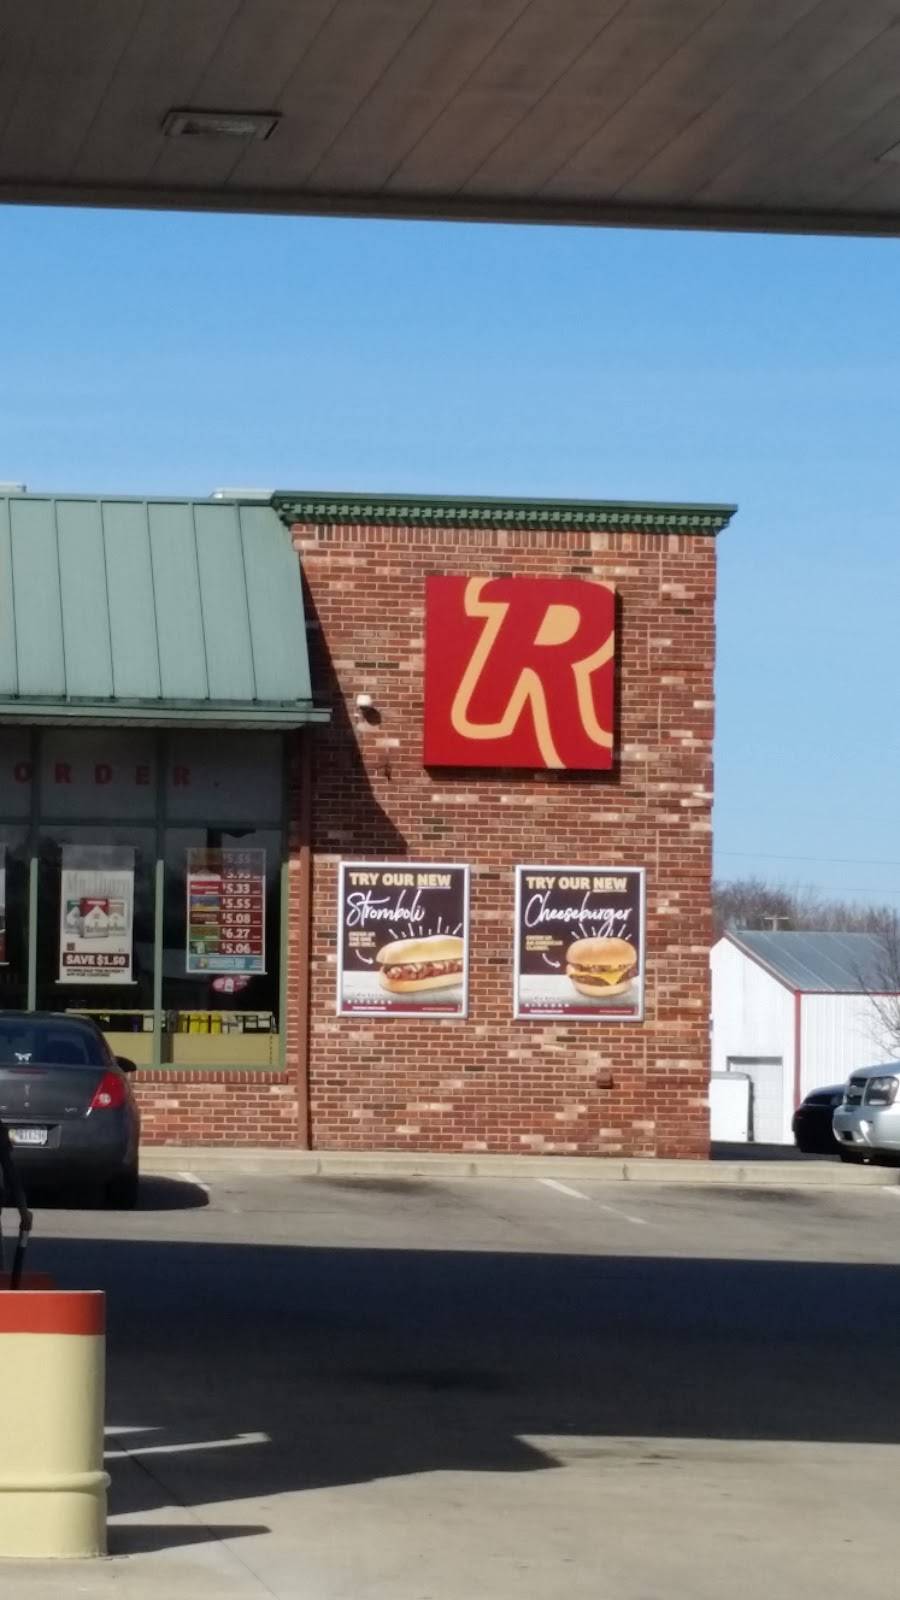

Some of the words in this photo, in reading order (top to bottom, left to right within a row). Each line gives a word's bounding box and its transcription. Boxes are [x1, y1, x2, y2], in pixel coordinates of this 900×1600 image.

[451, 576, 615, 769] R
[349, 872, 380, 886] TRY
[382, 873, 414, 886] OUR
[417, 874, 451, 888] NEW
[526, 876, 556, 889] TRY
[558, 877, 590, 890] OUR
[593, 877, 627, 891] NEW
[346, 889, 425, 927] Stromboli
[525, 890, 633, 937] Cheeseburger
[66, 954, 95, 965] SAVE
[96, 954, 126, 966] $1.50
